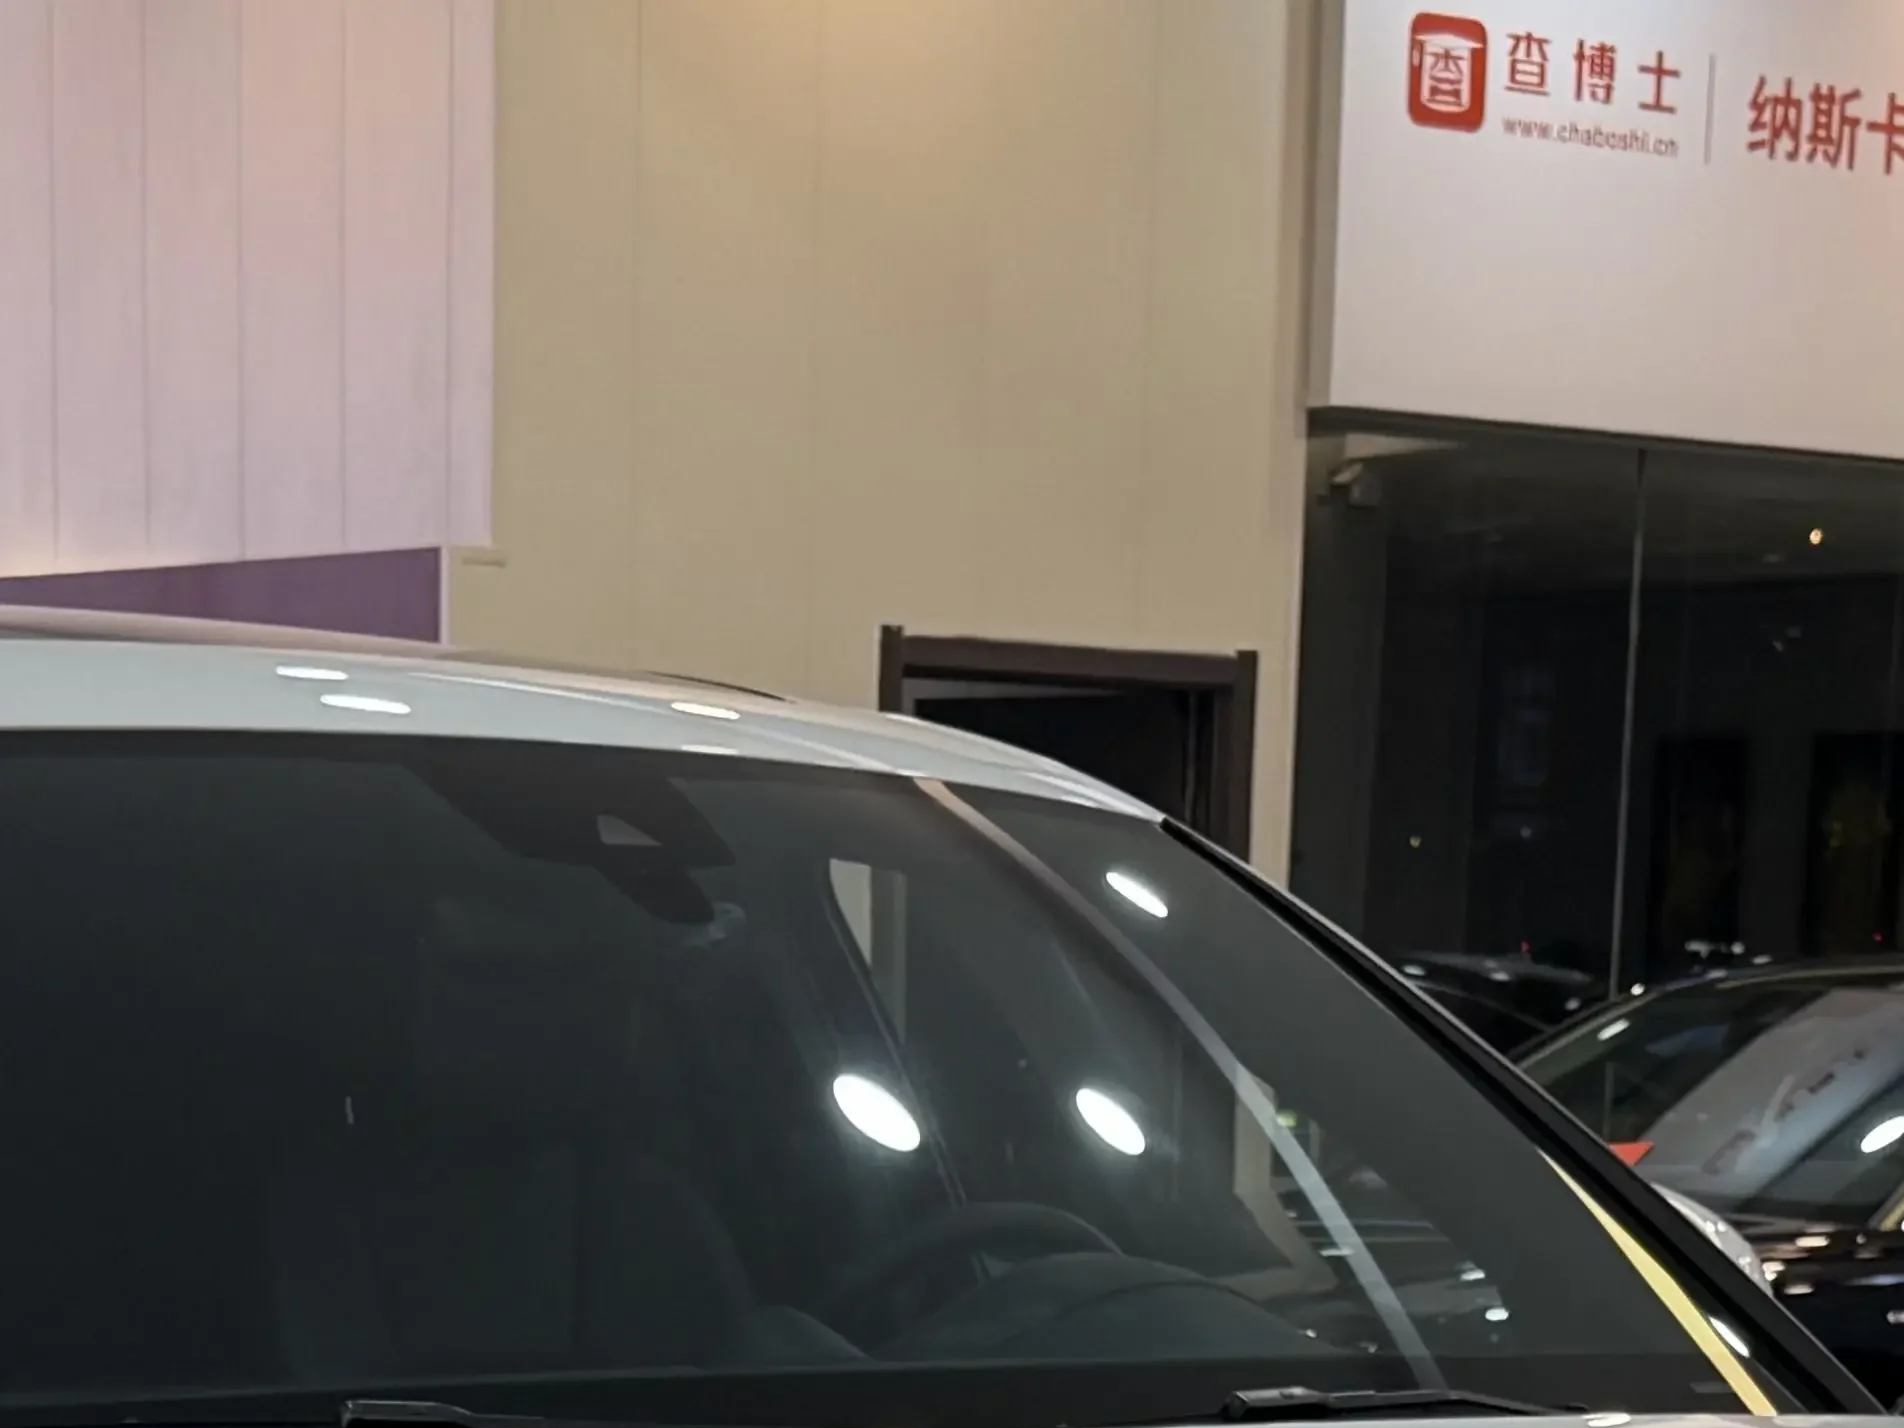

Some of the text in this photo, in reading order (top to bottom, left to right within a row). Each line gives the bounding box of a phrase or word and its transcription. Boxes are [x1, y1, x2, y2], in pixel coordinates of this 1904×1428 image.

[1504, 31, 1681, 114] 查博士
[1501, 116, 1680, 158] www.chaboshi.cn
